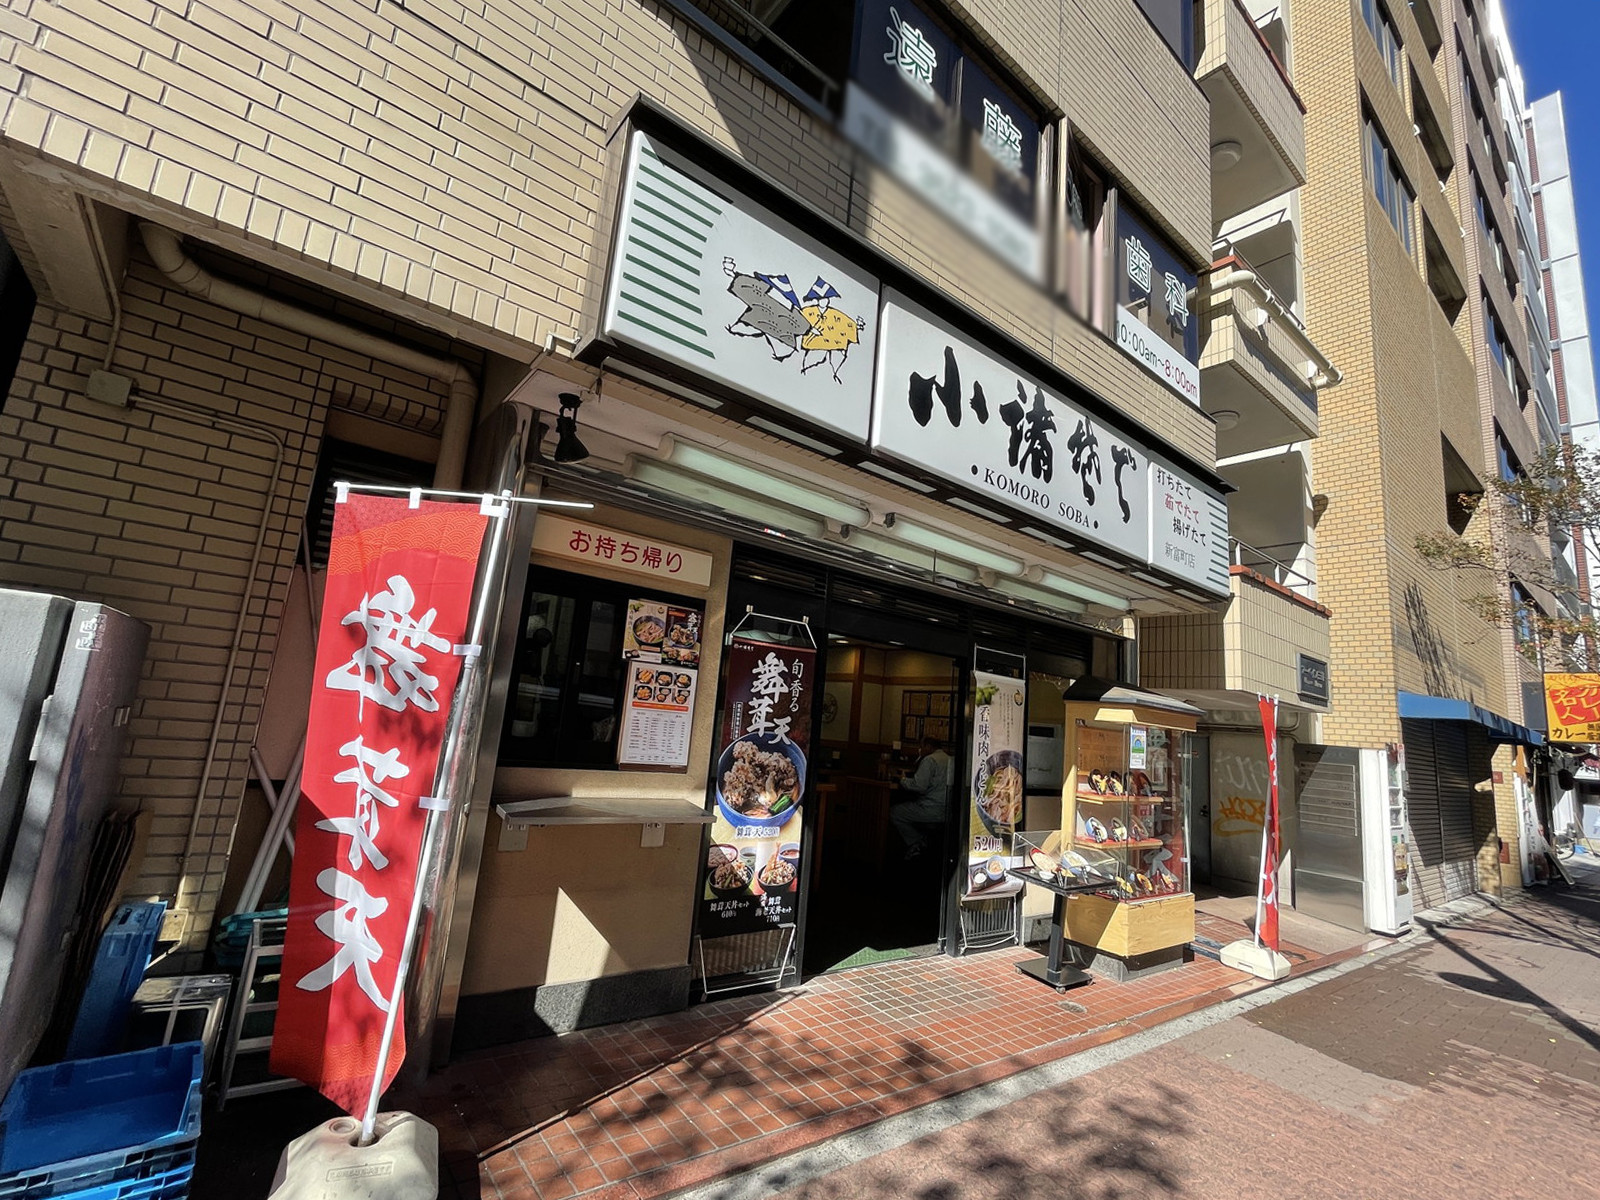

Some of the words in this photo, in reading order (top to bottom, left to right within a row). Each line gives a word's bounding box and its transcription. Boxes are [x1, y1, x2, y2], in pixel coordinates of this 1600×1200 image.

[984, 467, 1051, 510] KOMORO
[1058, 501, 1091, 529] SOBA
[1156, 467, 1192, 501] 打ちたて
[1165, 492, 1200, 525] 茹でたて
[568, 529, 684, 573] お持ち帰り
[1173, 516, 1207, 547] 揚げたて
[746, 651, 792, 745] 舞茸天
[789, 658, 804, 713] 旬香る
[1554, 689, 1587, 721] 名人
[1552, 727, 1587, 740] カレー
[976, 705, 991, 806] 香味肉うどん
